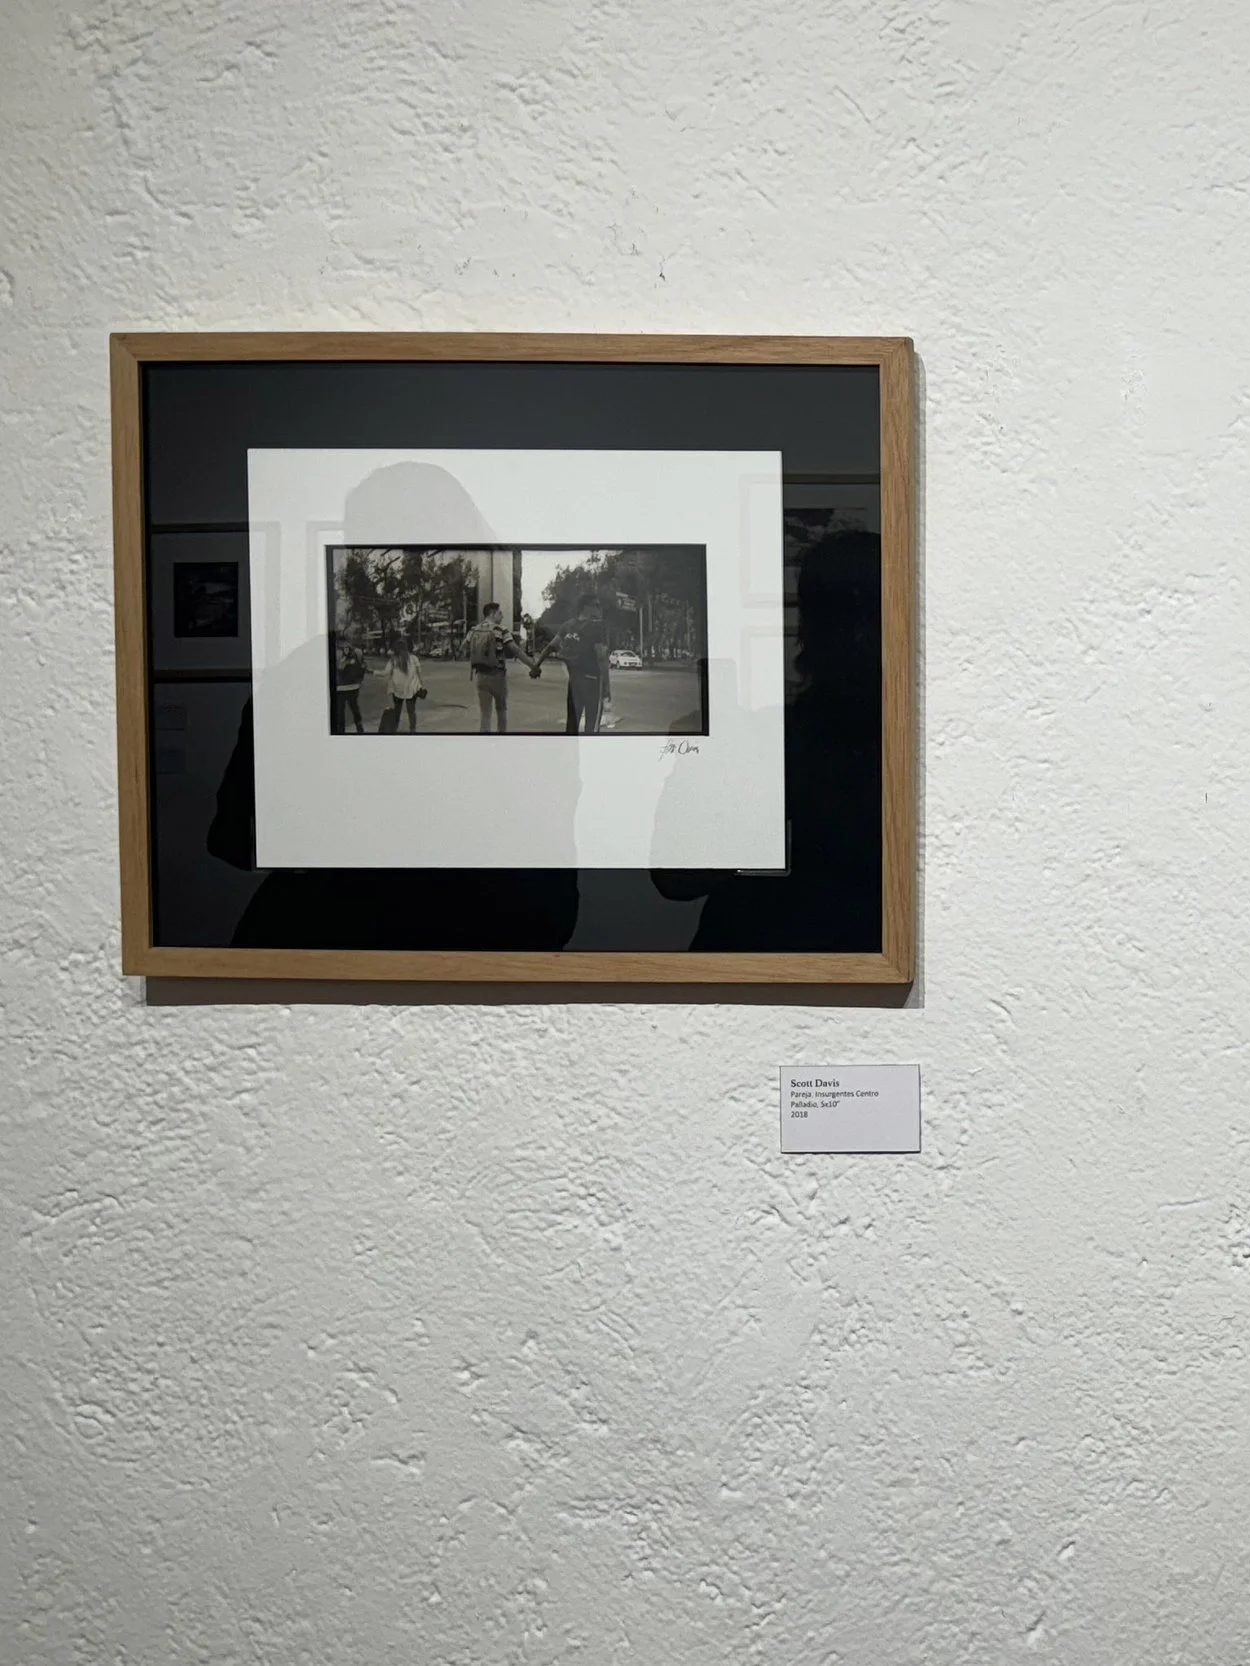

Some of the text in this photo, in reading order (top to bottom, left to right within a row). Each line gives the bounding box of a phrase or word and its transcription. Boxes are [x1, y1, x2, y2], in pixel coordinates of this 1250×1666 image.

[790, 1079, 840, 1088] Scott Davis
[815, 1090, 854, 1099] Insurgentes
[790, 1100, 819, 1109] Palladio,
